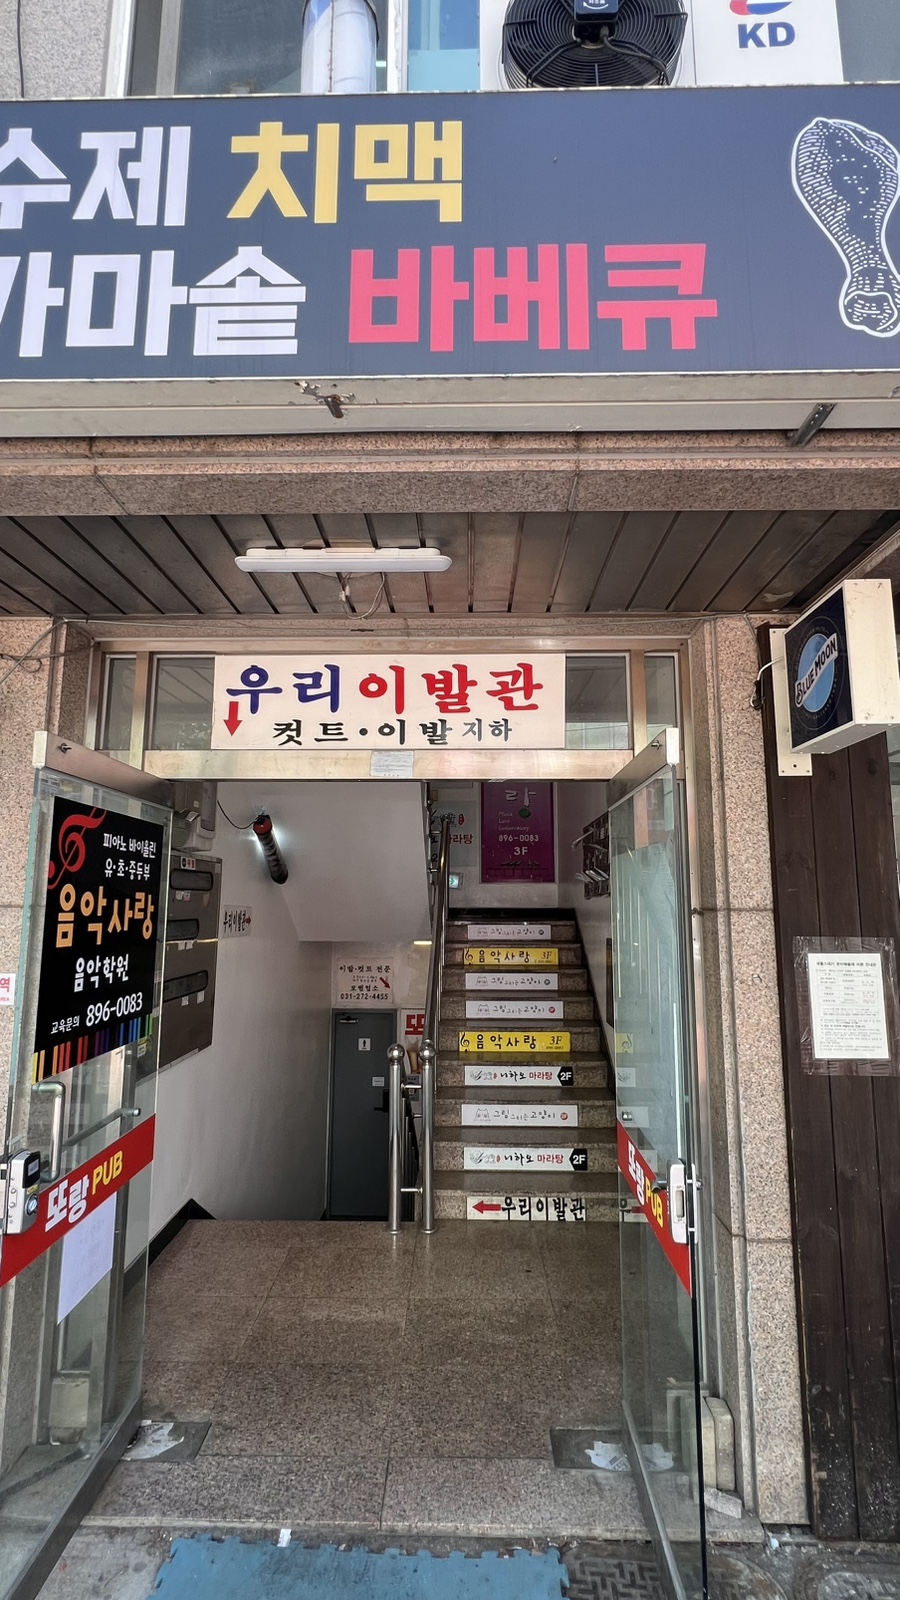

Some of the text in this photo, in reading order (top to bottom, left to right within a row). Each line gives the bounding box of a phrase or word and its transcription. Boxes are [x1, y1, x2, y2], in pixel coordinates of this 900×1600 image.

[738, 22, 795, 48] KD
[0, 121, 463, 228] 수제 치맥
[0, 243, 717, 357] 가마솥 바베큐
[796, 668, 815, 705] BLUE
[814, 637, 838, 677] MOON
[103, 833, 156, 858] 피아노 바이올린
[498, 834, 539, 842] 896-0083
[513, 846, 528, 856] 3F
[55, 883, 154, 948] 음악사랑
[479, 949, 552, 963] 음악사랑 3F
[74, 953, 129, 993] 음악학원
[50, 991, 143, 1034] 교육문의 896-0083
[477, 1034, 563, 1049] 음악사랑 3F
[529, 1071, 553, 1080] 마라탕
[560, 1072, 573, 1080] 2F
[536, 1154, 564, 1164] 마라탕
[572, 1155, 586, 1164] 2F
[45, 1151, 123, 1233] 또랑 PUB
